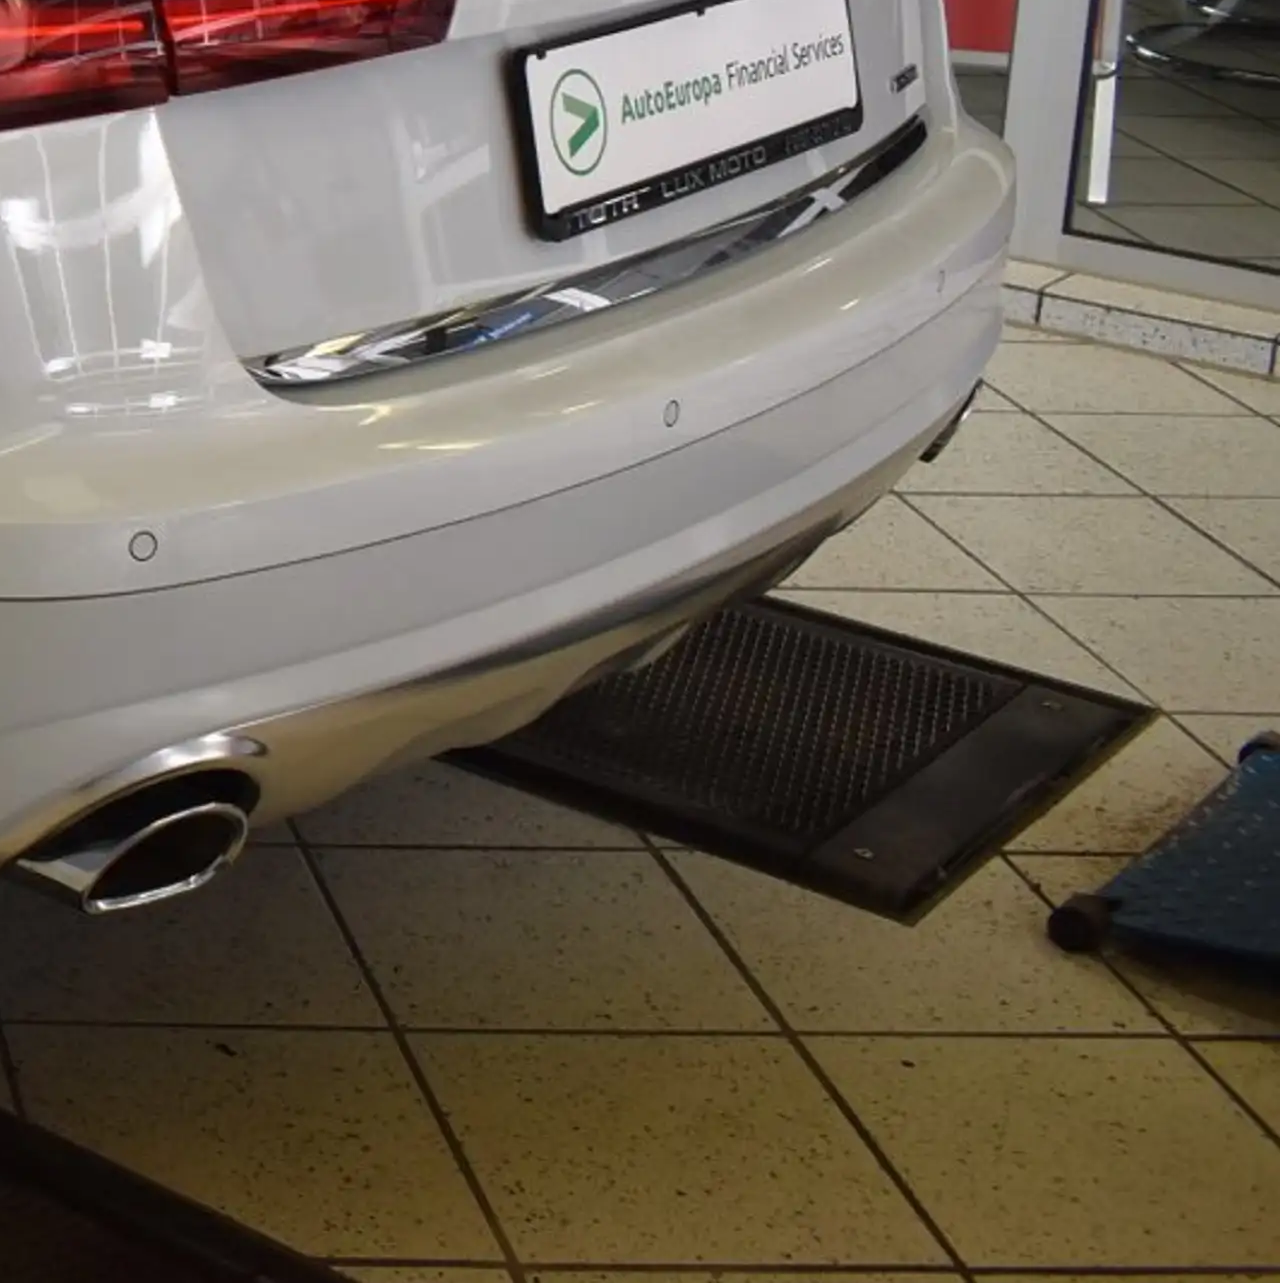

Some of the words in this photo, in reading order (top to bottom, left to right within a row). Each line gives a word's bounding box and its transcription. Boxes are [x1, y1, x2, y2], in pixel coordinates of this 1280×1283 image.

[621, 71, 722, 124] AutoEuropa
[725, 44, 790, 90] Financial
[792, 32, 844, 70] Services
